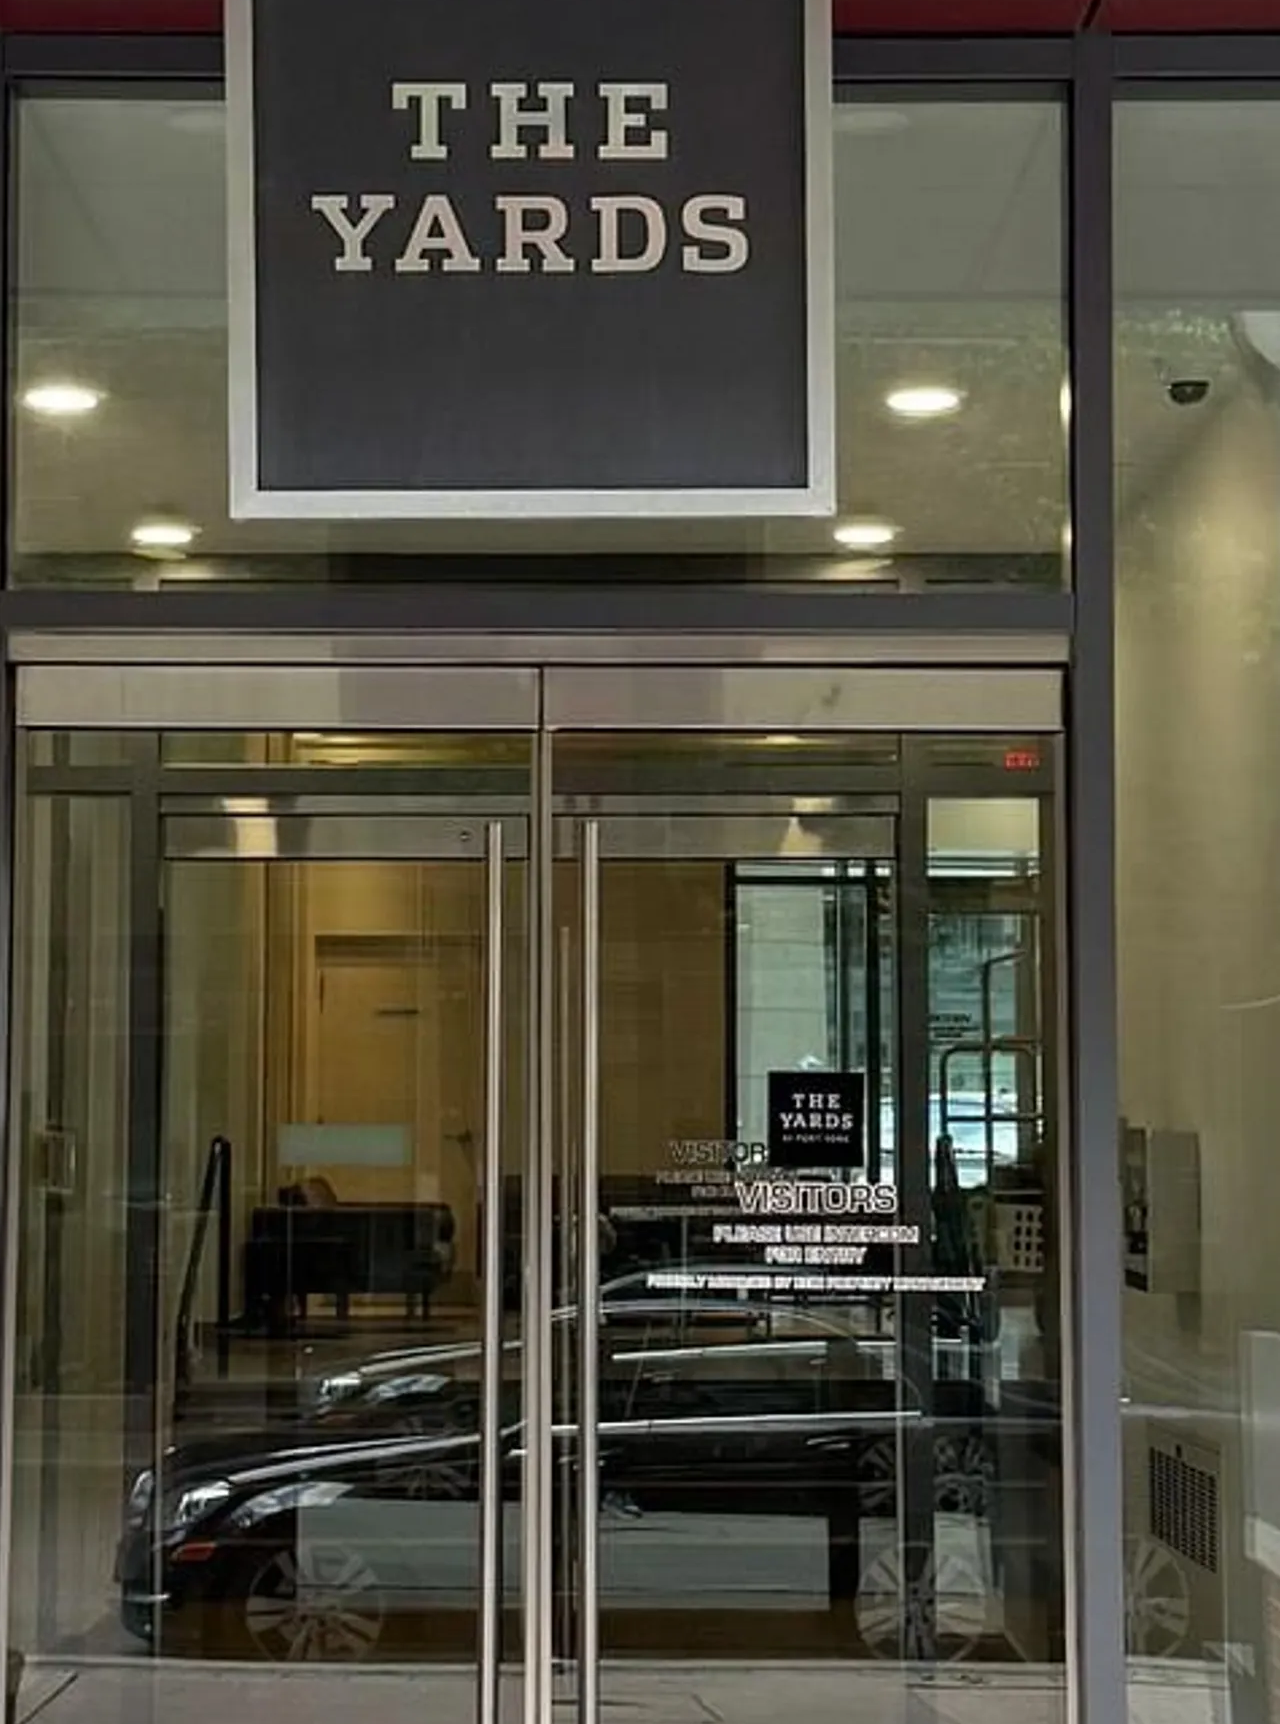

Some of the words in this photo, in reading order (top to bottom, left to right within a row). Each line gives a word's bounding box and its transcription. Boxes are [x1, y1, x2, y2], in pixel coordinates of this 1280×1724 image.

[391, 83, 669, 161] THE
[310, 194, 751, 274] YARDS
[791, 1092, 842, 1110] THE
[779, 1112, 855, 1131] YARDS
[670, 1139, 767, 1165] VISITOR
[734, 1181, 899, 1215] VISITORS
